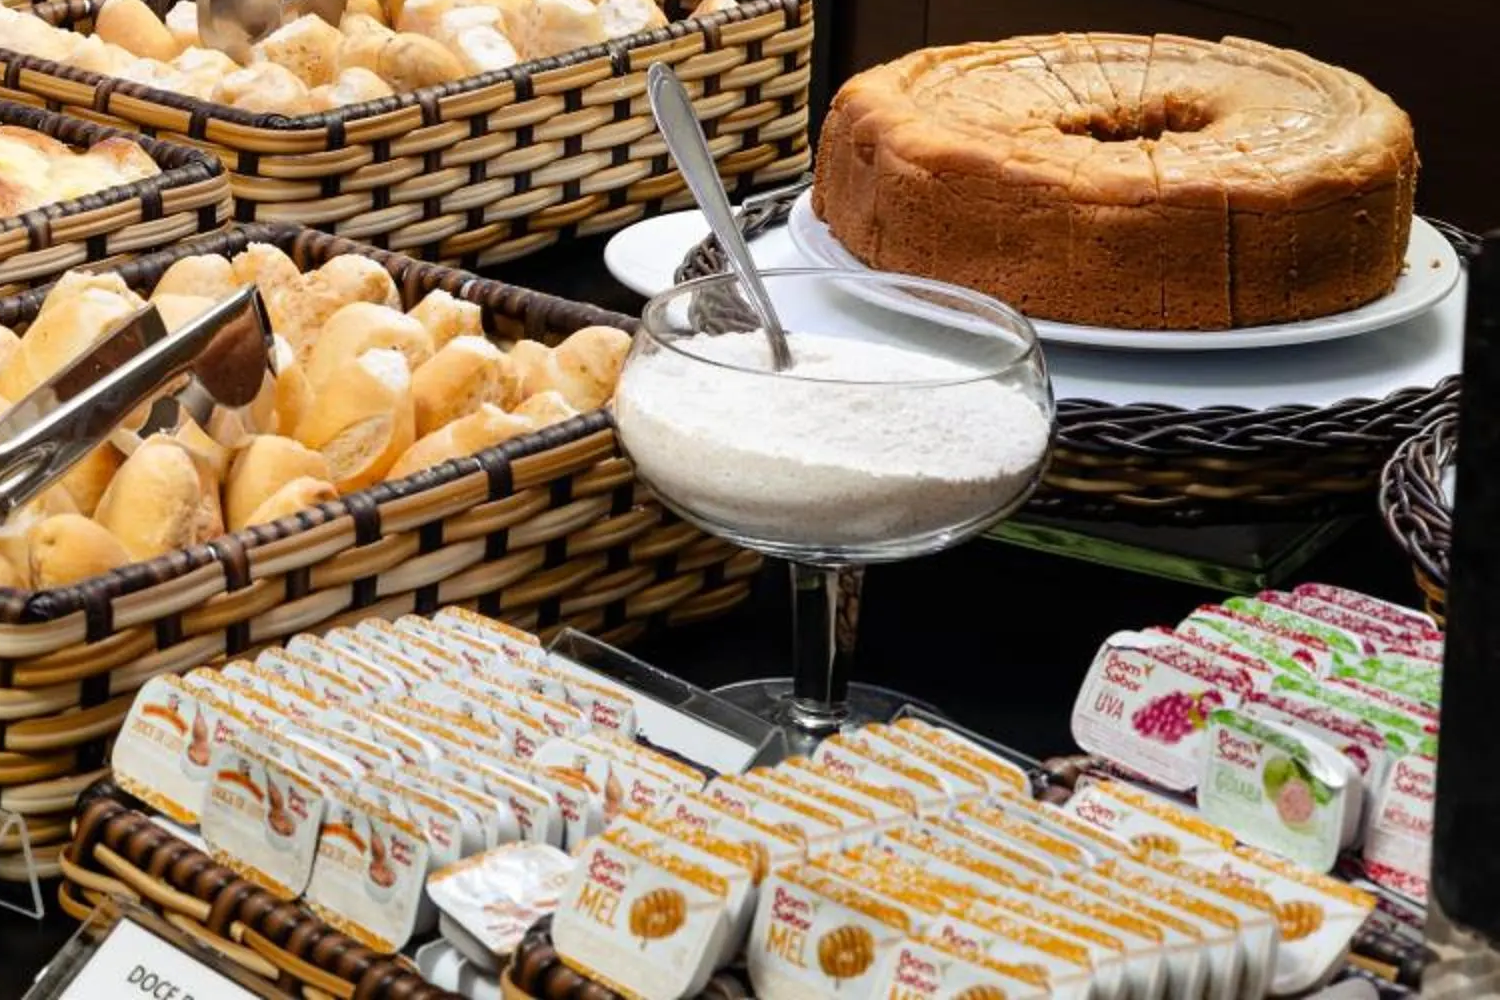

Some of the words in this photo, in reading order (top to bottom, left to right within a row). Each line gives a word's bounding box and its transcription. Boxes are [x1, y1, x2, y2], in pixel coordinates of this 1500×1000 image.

[1105, 651, 1141, 677] Bom
[1103, 667, 1143, 692] Sabor
[1094, 691, 1125, 720] UVA
[1218, 729, 1255, 752] Bom
[1397, 761, 1433, 785] Bom
[592, 848, 627, 876] Bom
[589, 863, 626, 893] Sabor
[574, 882, 621, 930] MEL
[774, 886, 811, 913] Bom
[771, 903, 812, 931] Sabor
[766, 922, 807, 968] MEL
[900, 949, 937, 976] Bom
[127, 964, 181, 1000] DOCE
[896, 966, 938, 993] Sabor
